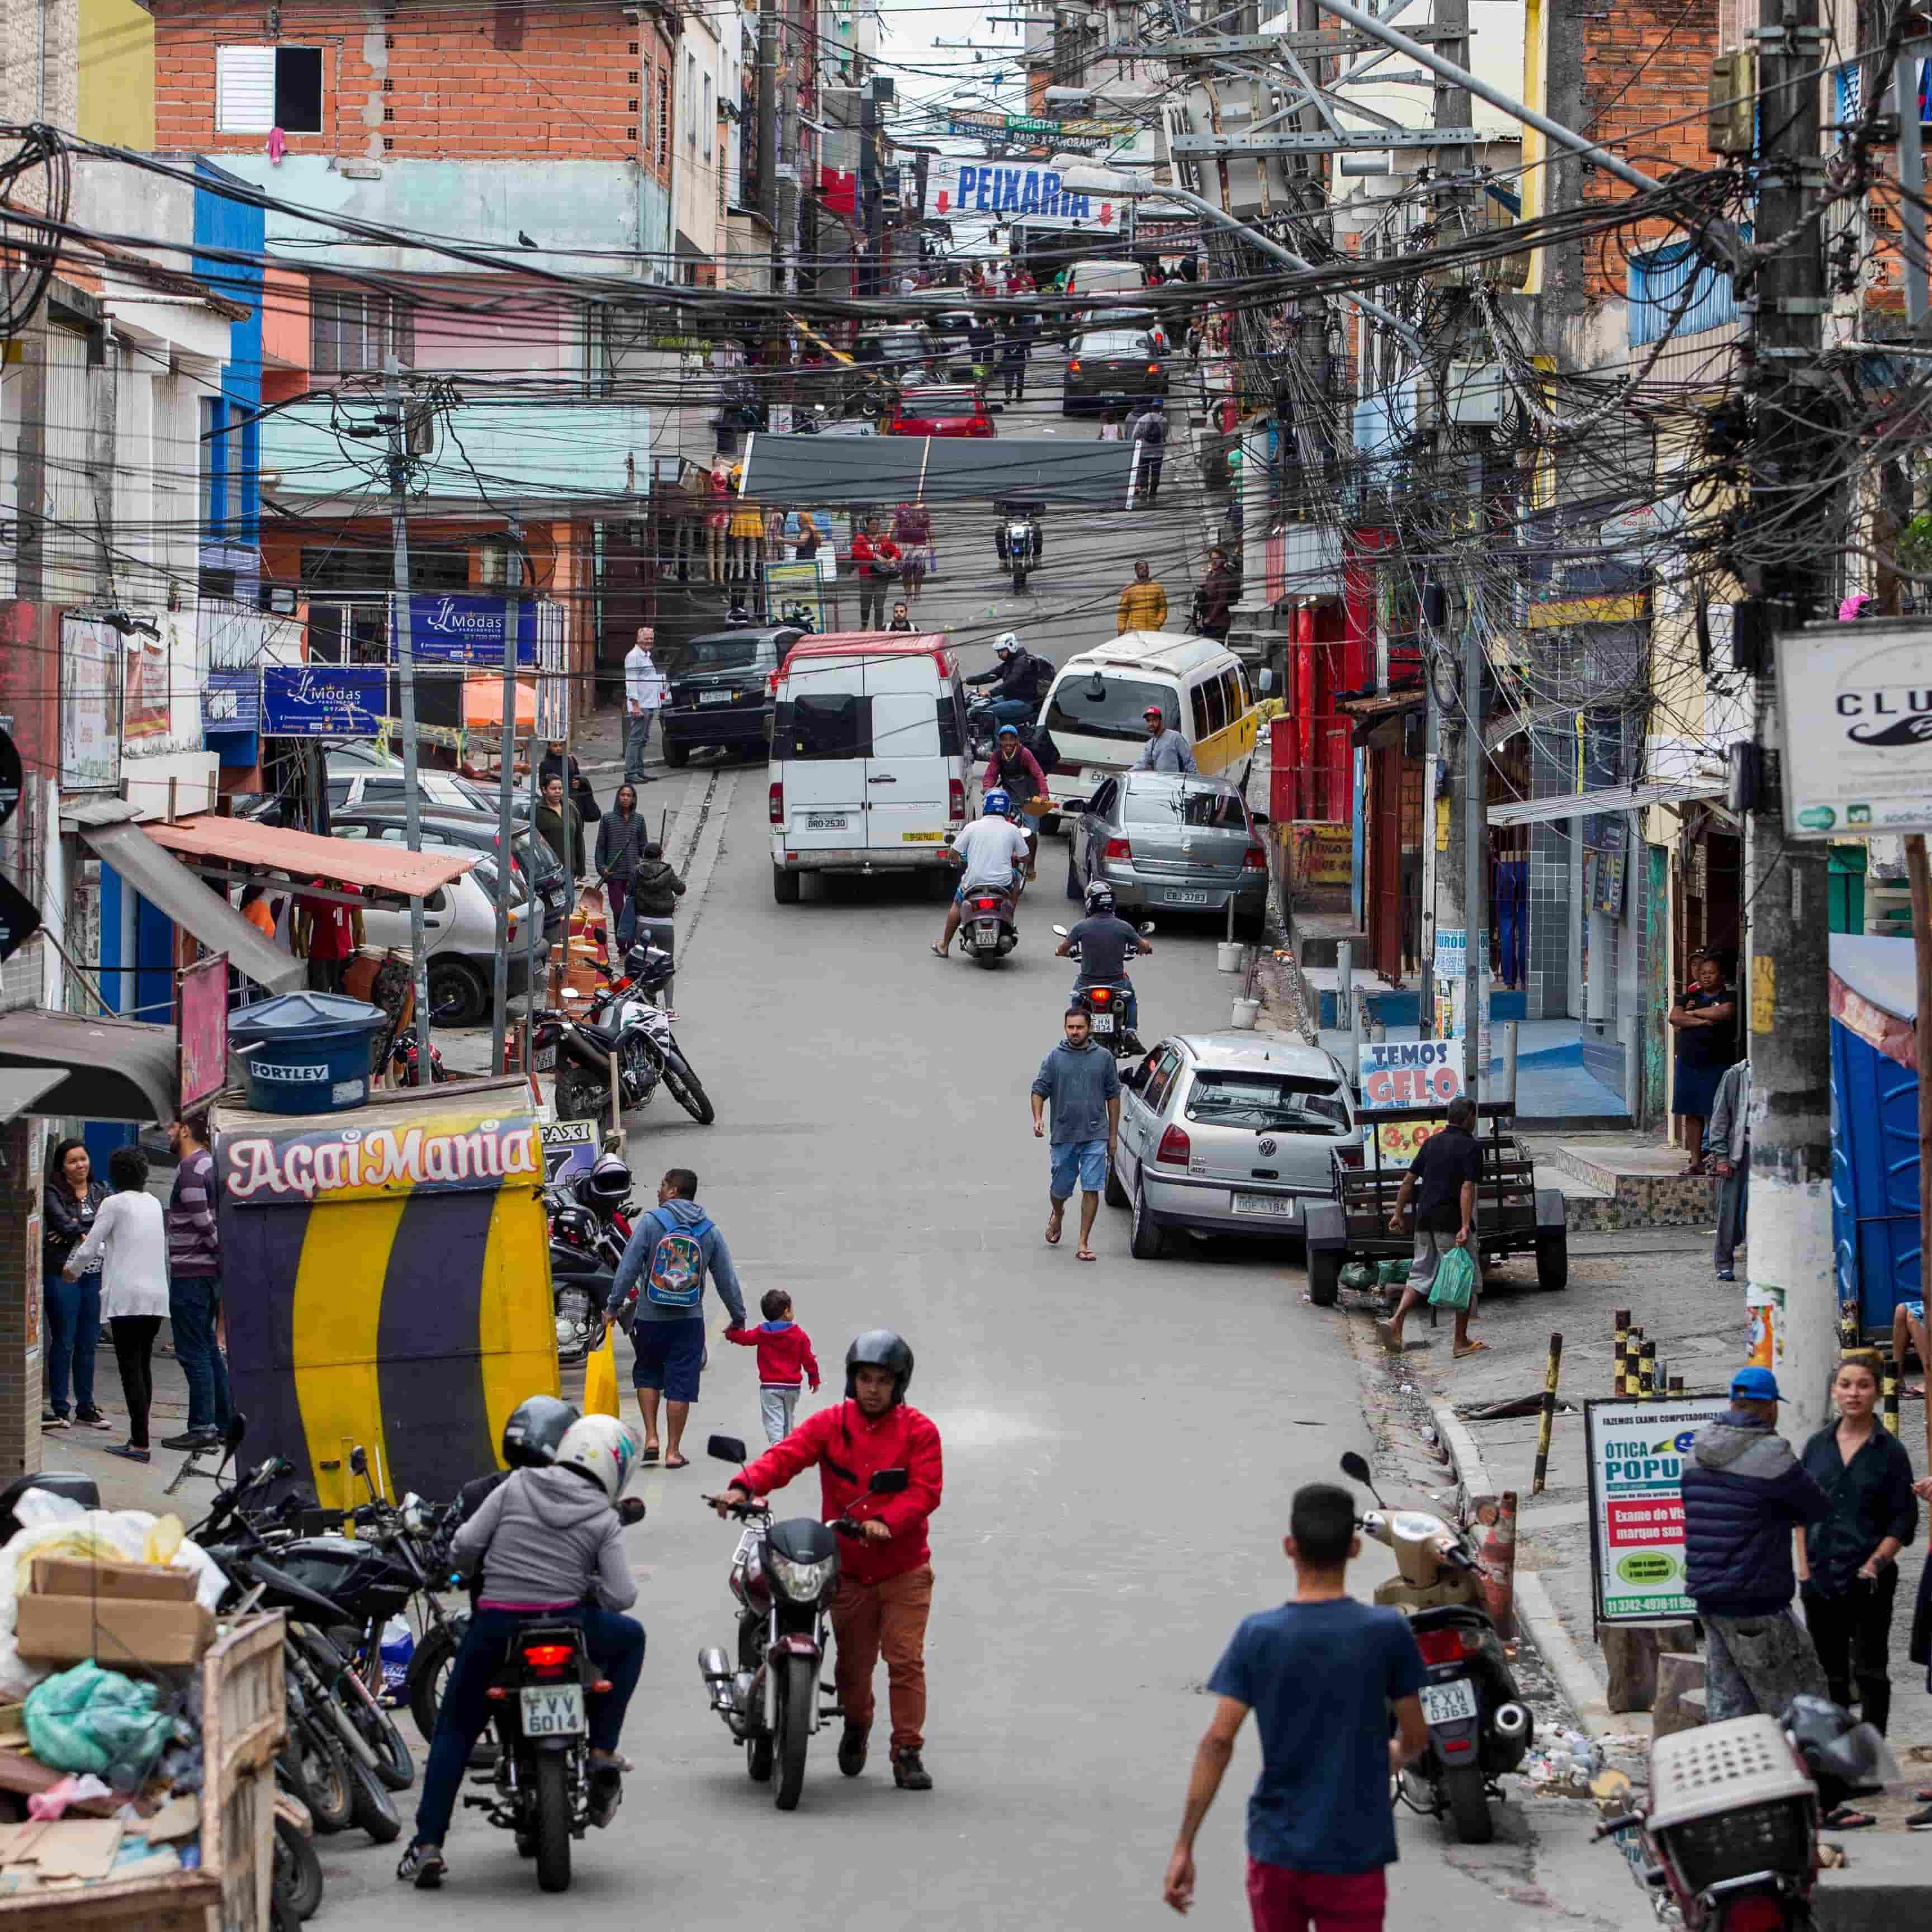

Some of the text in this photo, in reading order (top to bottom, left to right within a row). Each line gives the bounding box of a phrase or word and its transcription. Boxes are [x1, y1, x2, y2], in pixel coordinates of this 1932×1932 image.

[956, 166, 1091, 218] PEIXARIA
[452, 615, 502, 628] Modas
[311, 686, 362, 700] Modas
[1372, 1043, 1447, 1066] TEMOS
[252, 1060, 326, 1079] FORTLEV
[1368, 1067, 1458, 1101] GELO
[1384, 1126, 1447, 1150] 3,9
[1602, 1416, 1634, 1426] FAZEMOS
[1636, 1415, 1658, 1424] EXAME
[1605, 1439, 1649, 1459] ÓTICA
[1614, 1509, 1651, 1522] Exame
[1653, 1508, 1668, 1520] de
[1616, 1526, 1683, 1540] marque sua
[529, 1715, 578, 1732] 6014
